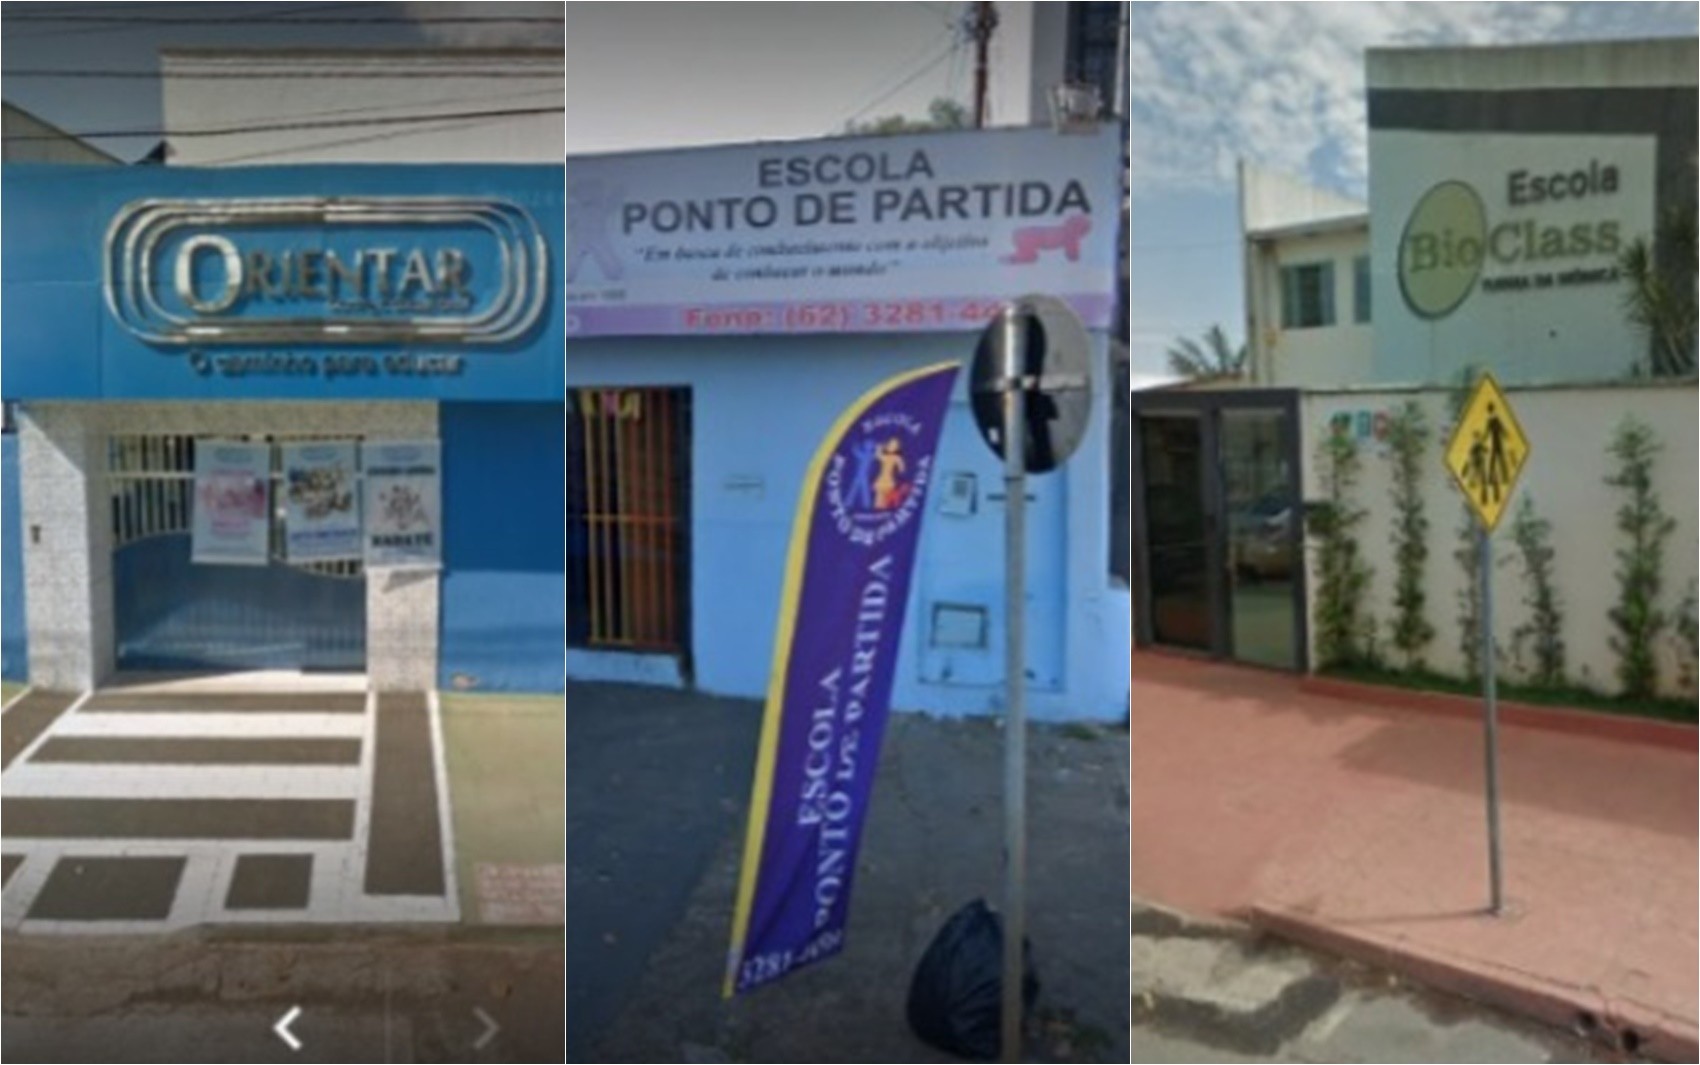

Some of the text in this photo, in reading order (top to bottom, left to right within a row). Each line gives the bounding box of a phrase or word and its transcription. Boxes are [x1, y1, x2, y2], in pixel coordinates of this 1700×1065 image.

[758, 150, 934, 188] ESCOLA
[1506, 159, 1619, 206] Escola
[622, 180, 1092, 234] PONTO DE PARTIDA
[683, 299, 1001, 330] Fone: (62) 3281-44
[188, 351, 465, 382] O caminho para educar
[798, 667, 842, 827] ESCOLA
[814, 791, 851, 929] PONTO
[844, 553, 893, 723] PARTIDA
